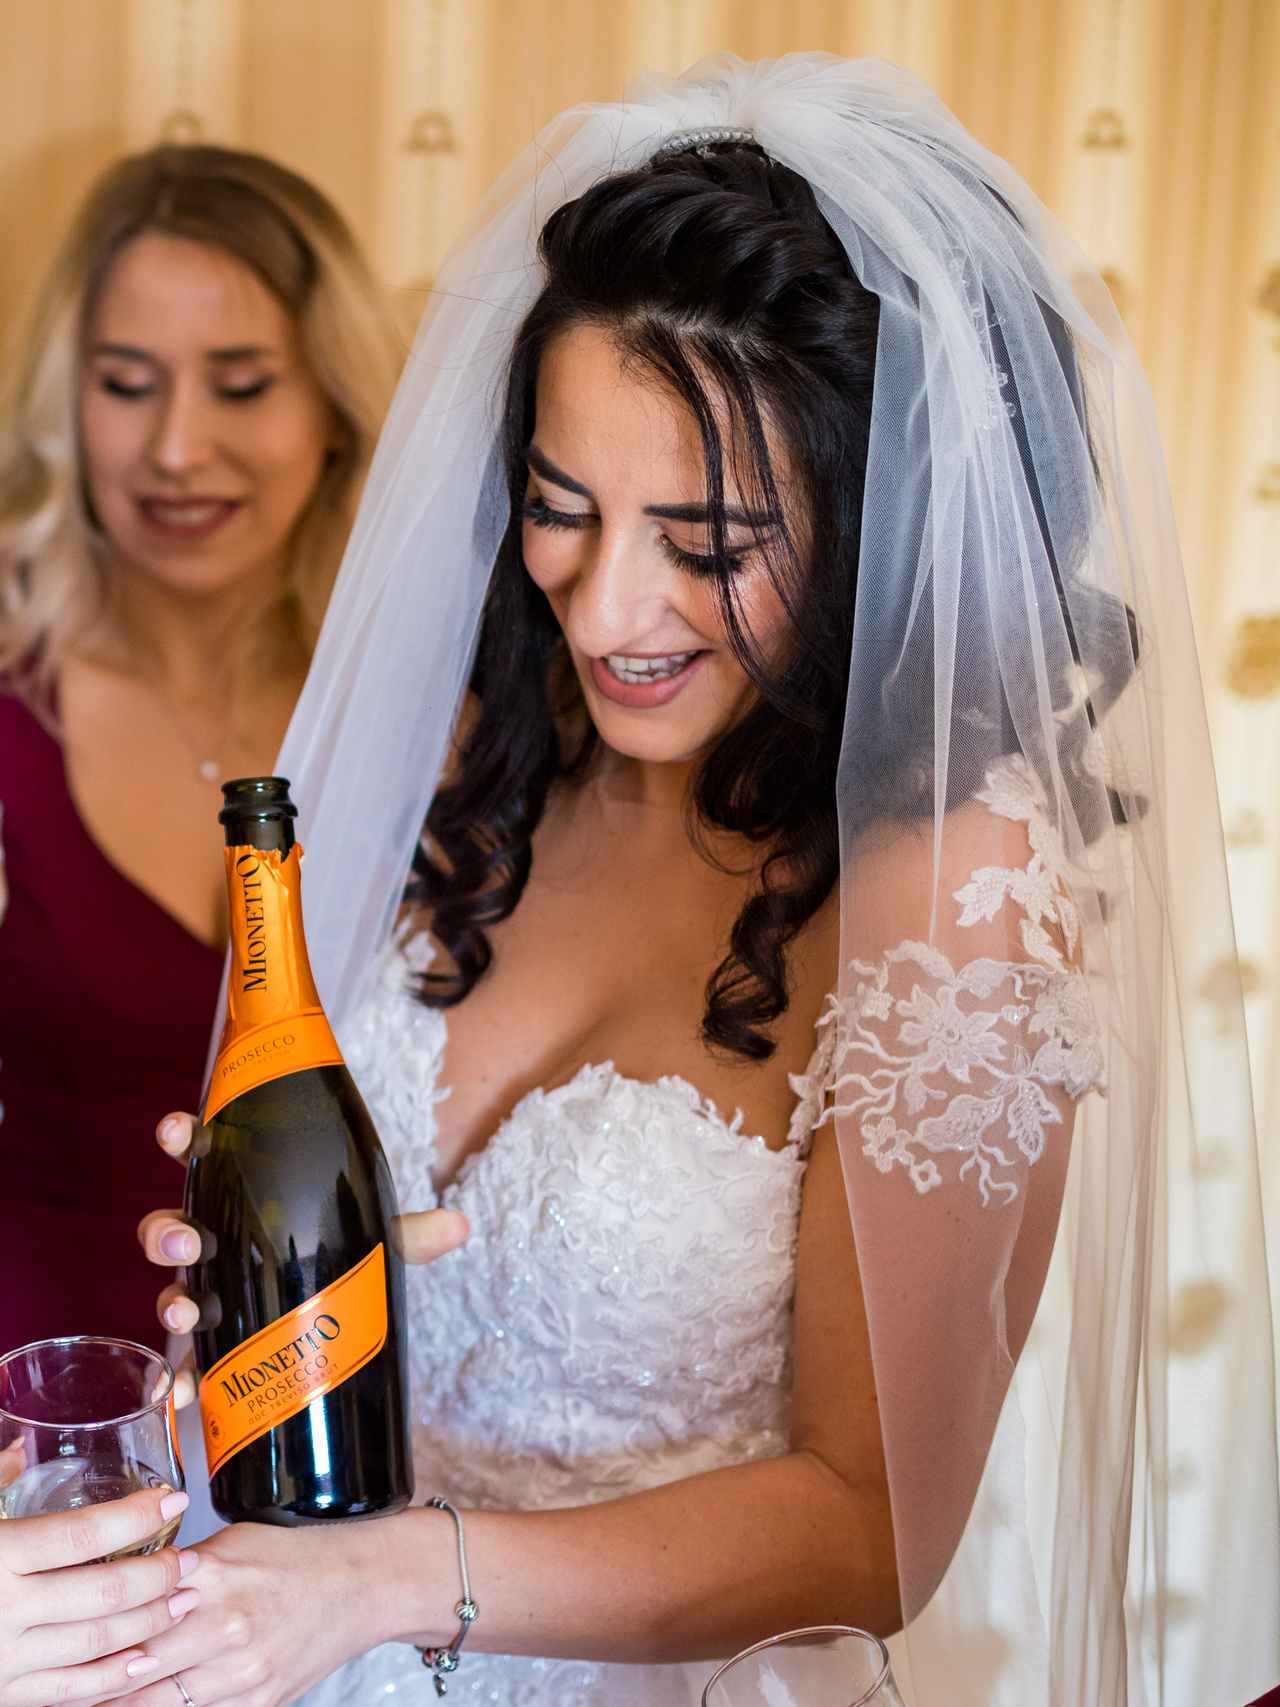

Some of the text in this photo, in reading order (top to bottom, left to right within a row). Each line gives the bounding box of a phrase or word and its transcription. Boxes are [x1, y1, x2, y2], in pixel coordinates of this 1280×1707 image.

[236, 854, 268, 993] MIONETTO
[222, 1034, 295, 1078] PROSECCO
[220, 1314, 340, 1407] MIONETTO
[247, 1355, 328, 1413] PROSECCO
[248, 1363, 338, 1425] DOC TREVISO BRUT
